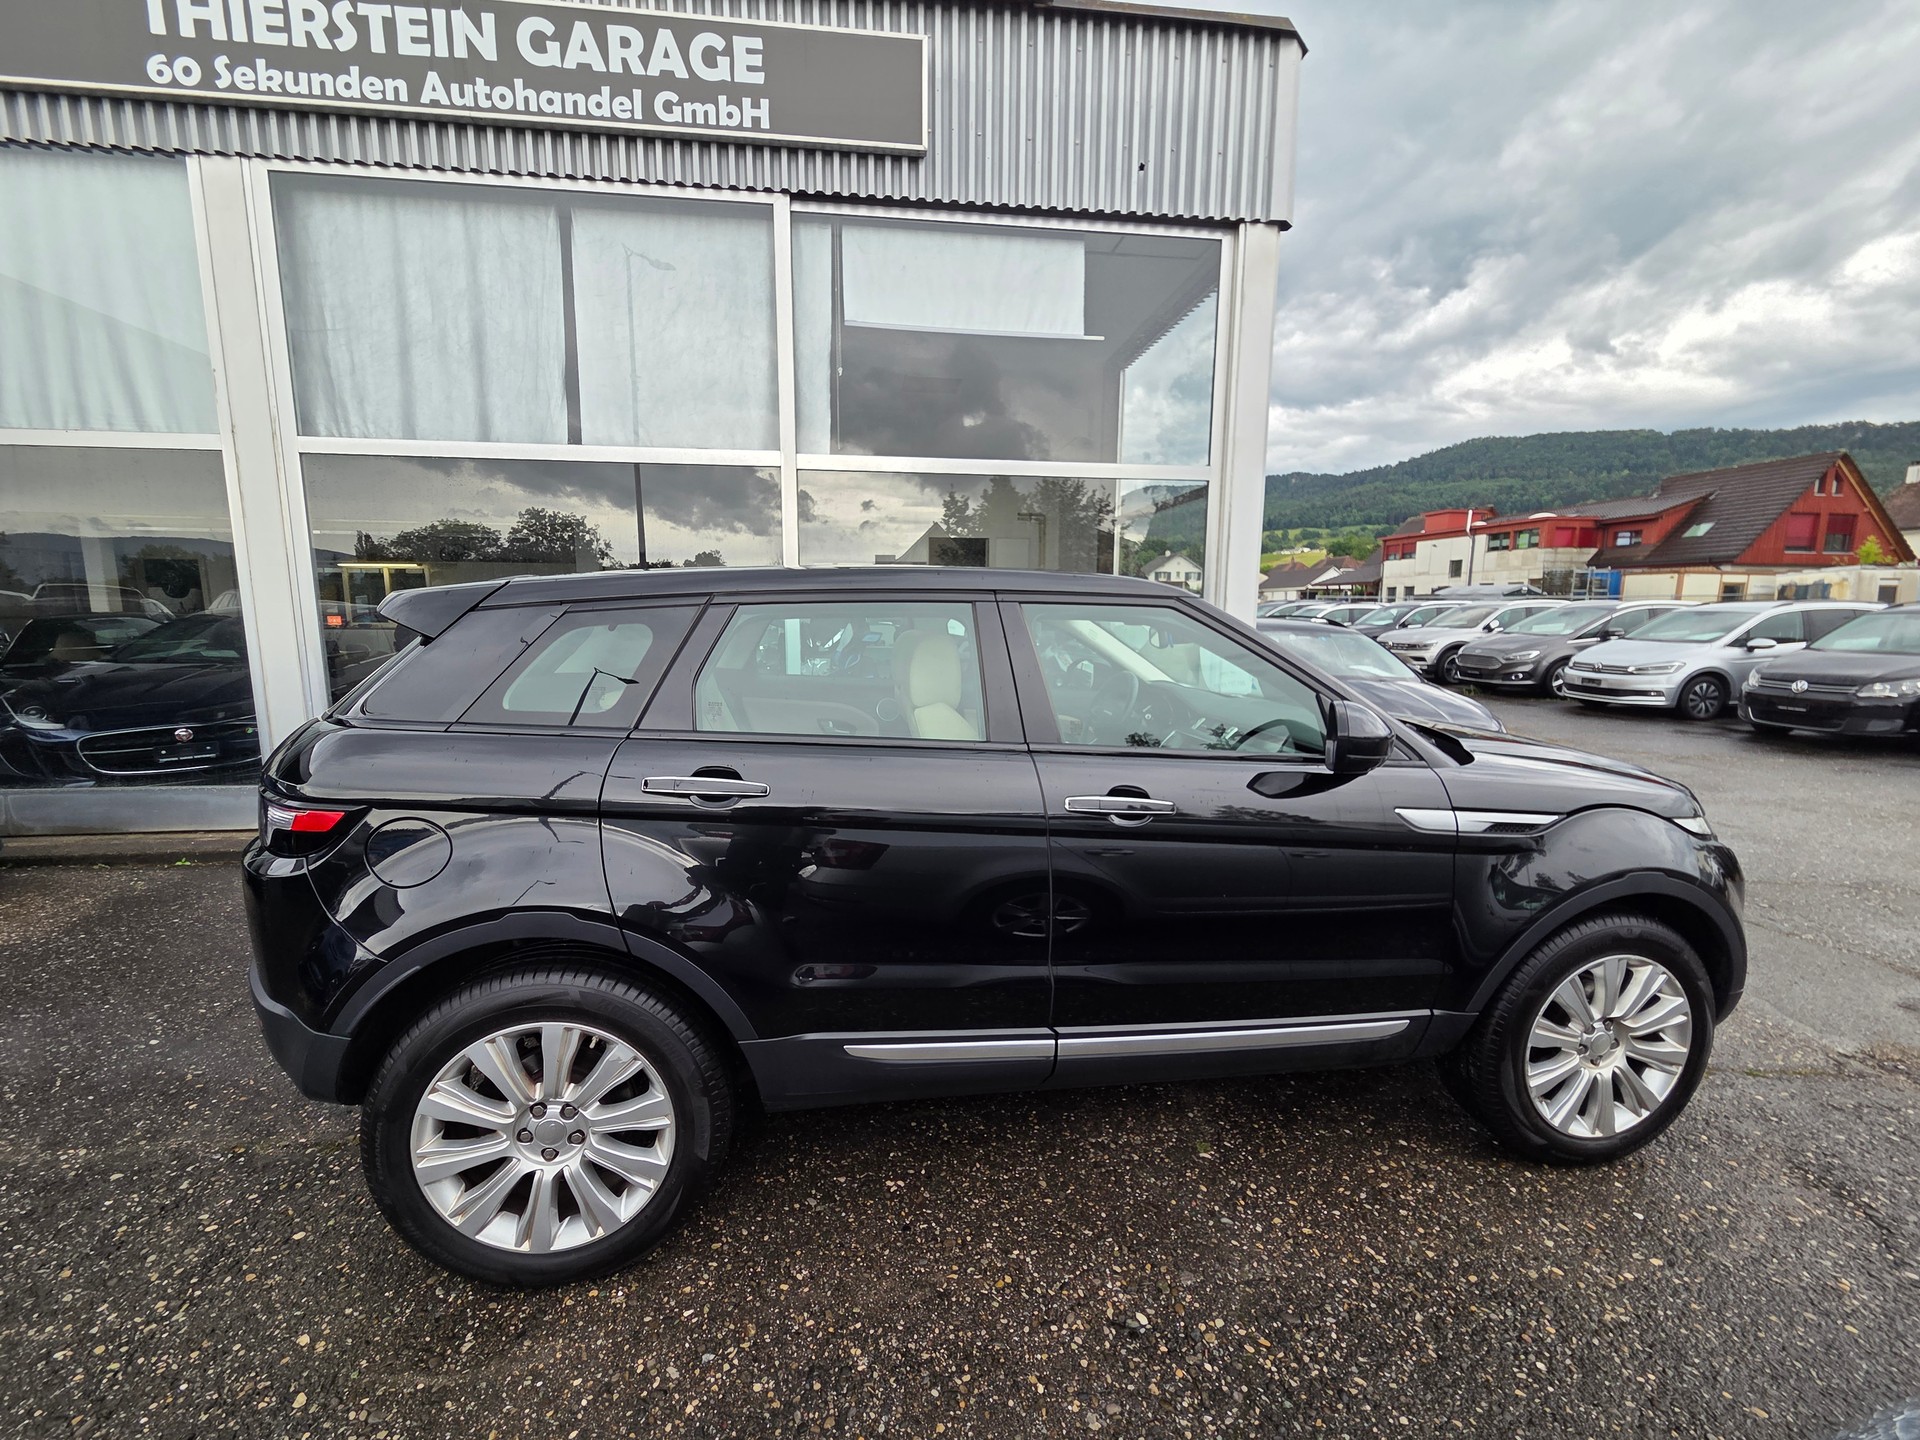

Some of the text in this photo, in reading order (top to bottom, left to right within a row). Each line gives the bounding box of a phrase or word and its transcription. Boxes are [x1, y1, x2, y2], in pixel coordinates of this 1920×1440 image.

[515, 16, 766, 85] GARAGE
[146, 53, 771, 130] 60 Sekunden Autohandel GmbH
